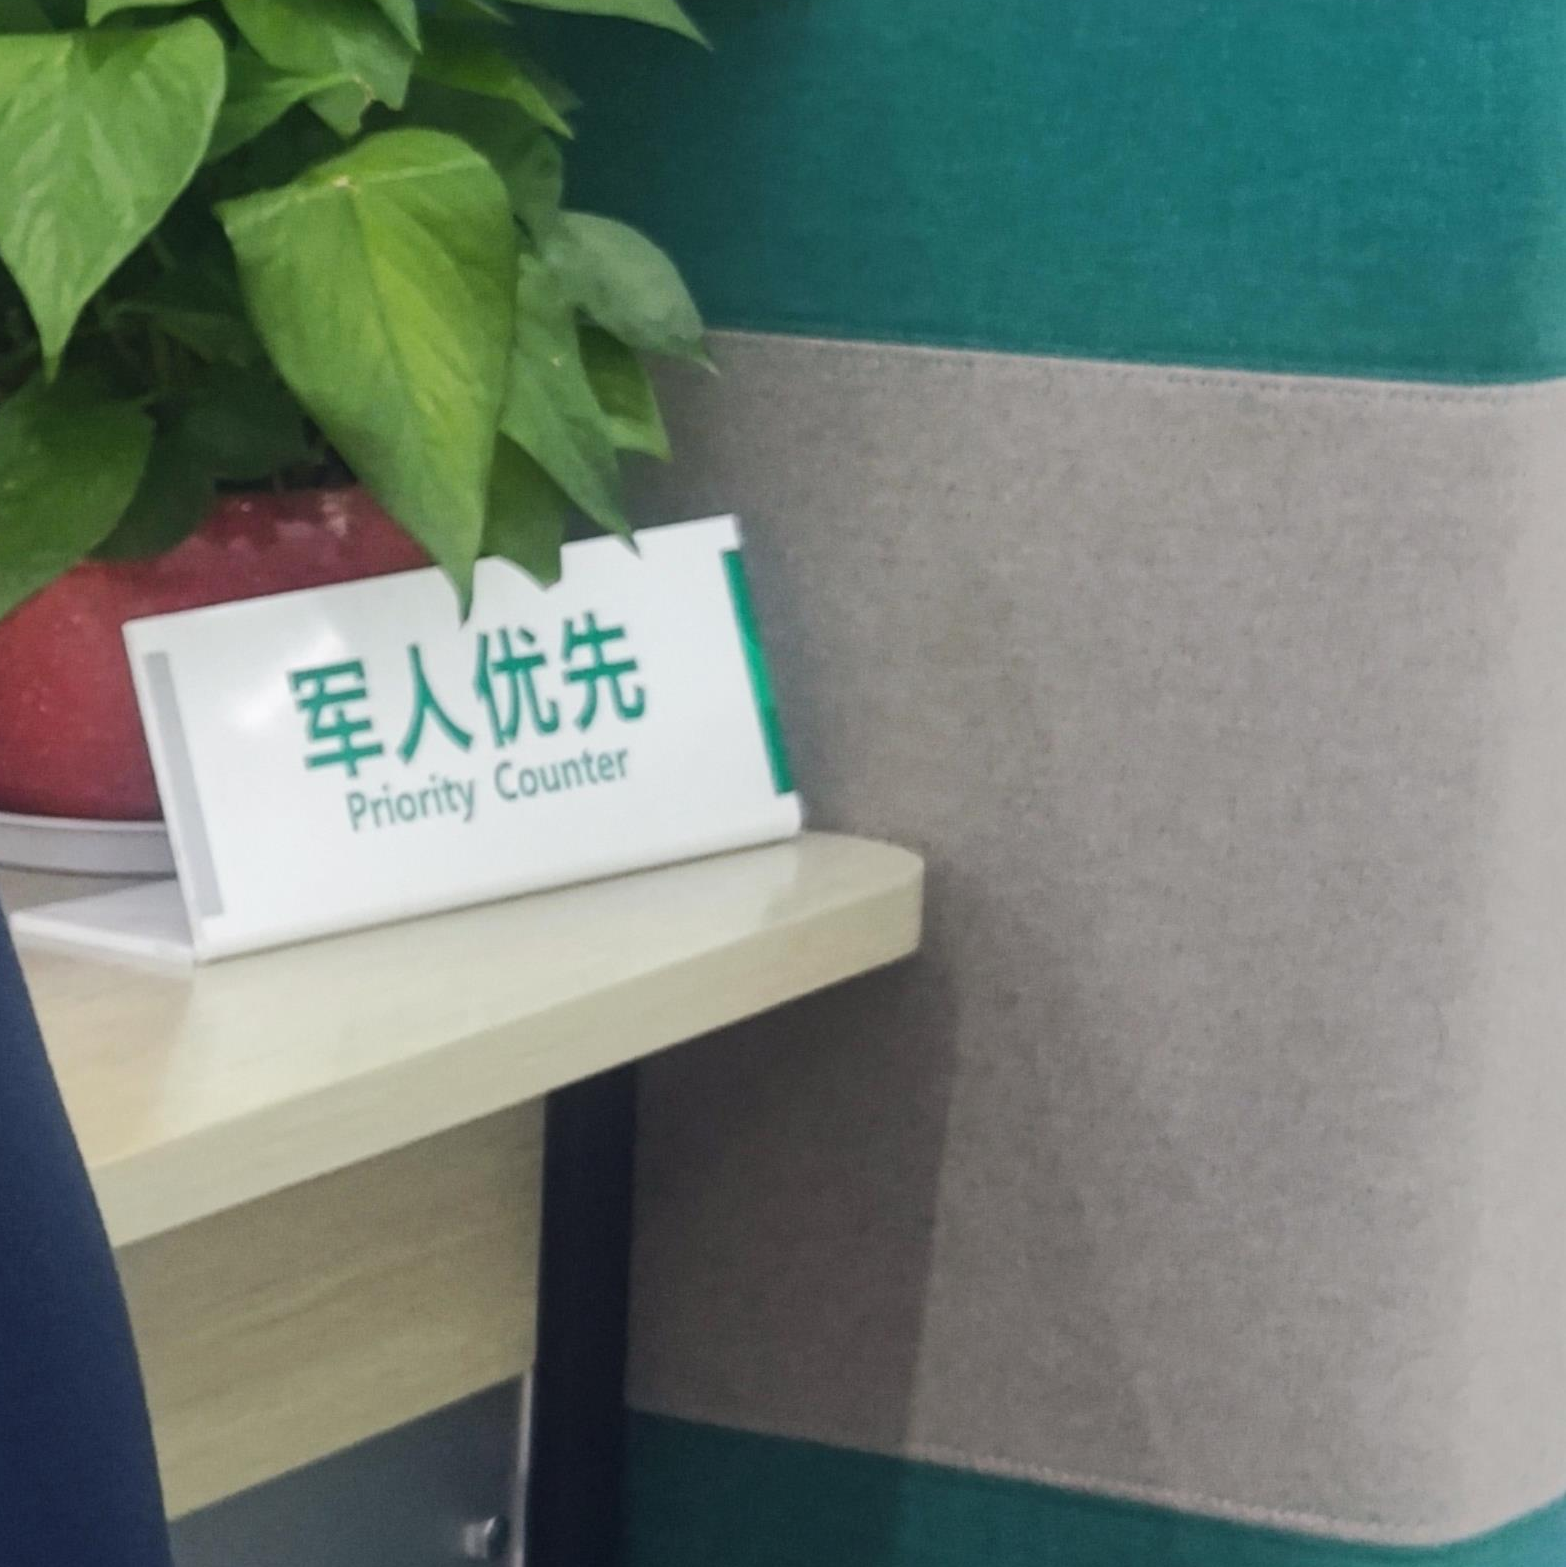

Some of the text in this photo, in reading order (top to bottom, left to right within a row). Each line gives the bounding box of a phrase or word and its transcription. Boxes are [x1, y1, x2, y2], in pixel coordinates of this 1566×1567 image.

[287, 610, 647, 779] 军人优先
[347, 743, 630, 832] Priority Counter
